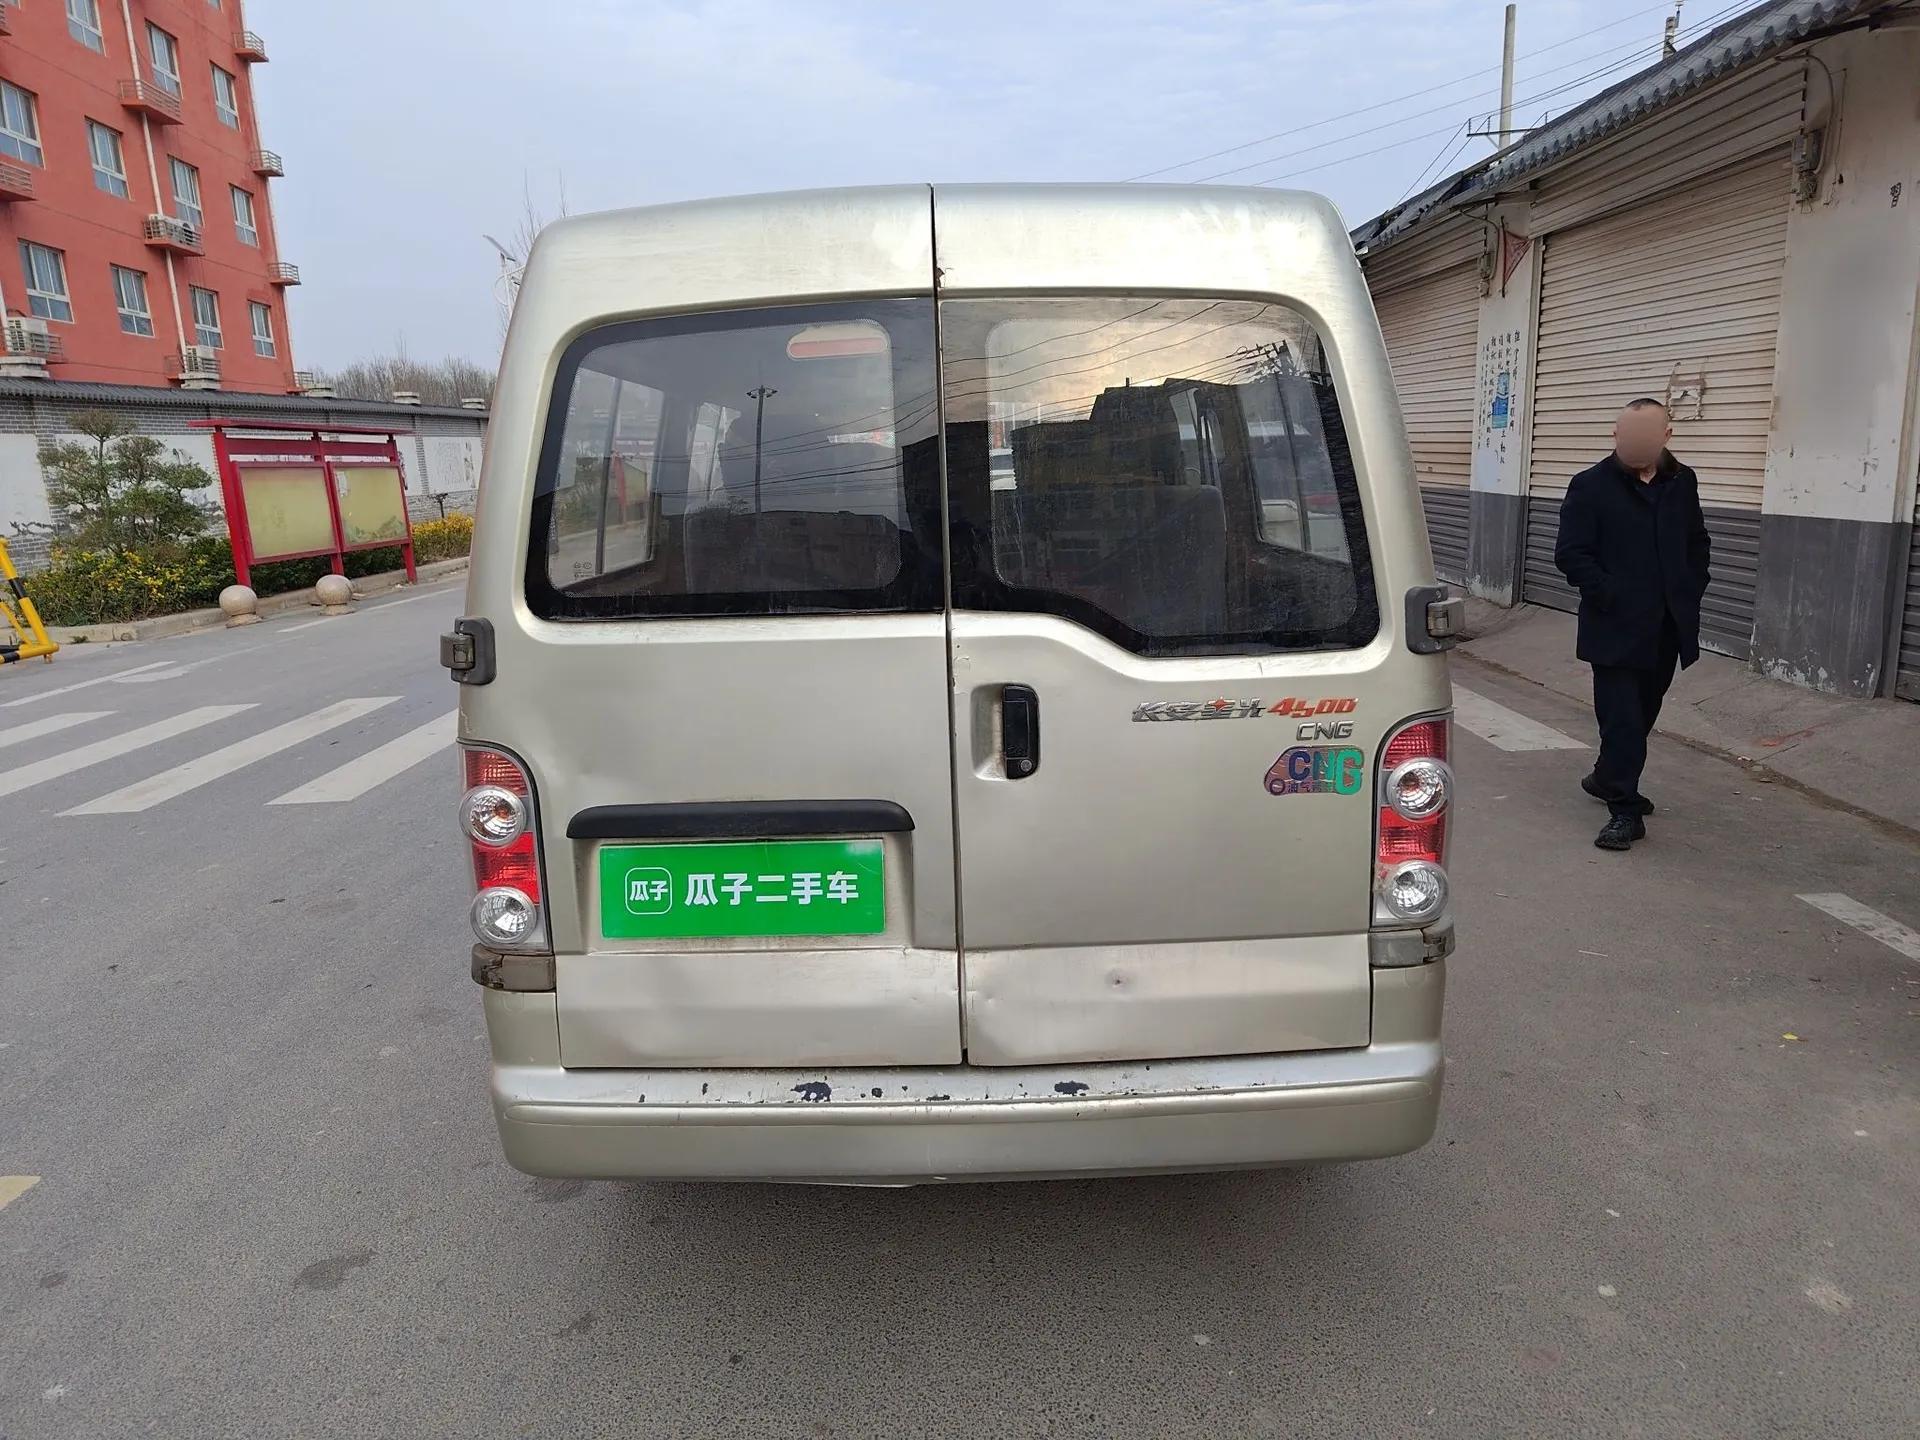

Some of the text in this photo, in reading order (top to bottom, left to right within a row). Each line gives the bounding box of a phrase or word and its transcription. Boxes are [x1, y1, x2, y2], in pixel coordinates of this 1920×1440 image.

[1267, 697, 1358, 718] 4500
[1296, 721, 1354, 740] CNG
[1288, 749, 1363, 795] CNG
[629, 880, 669, 902] 瓜子
[684, 871, 859, 907] 瓜子二手车
